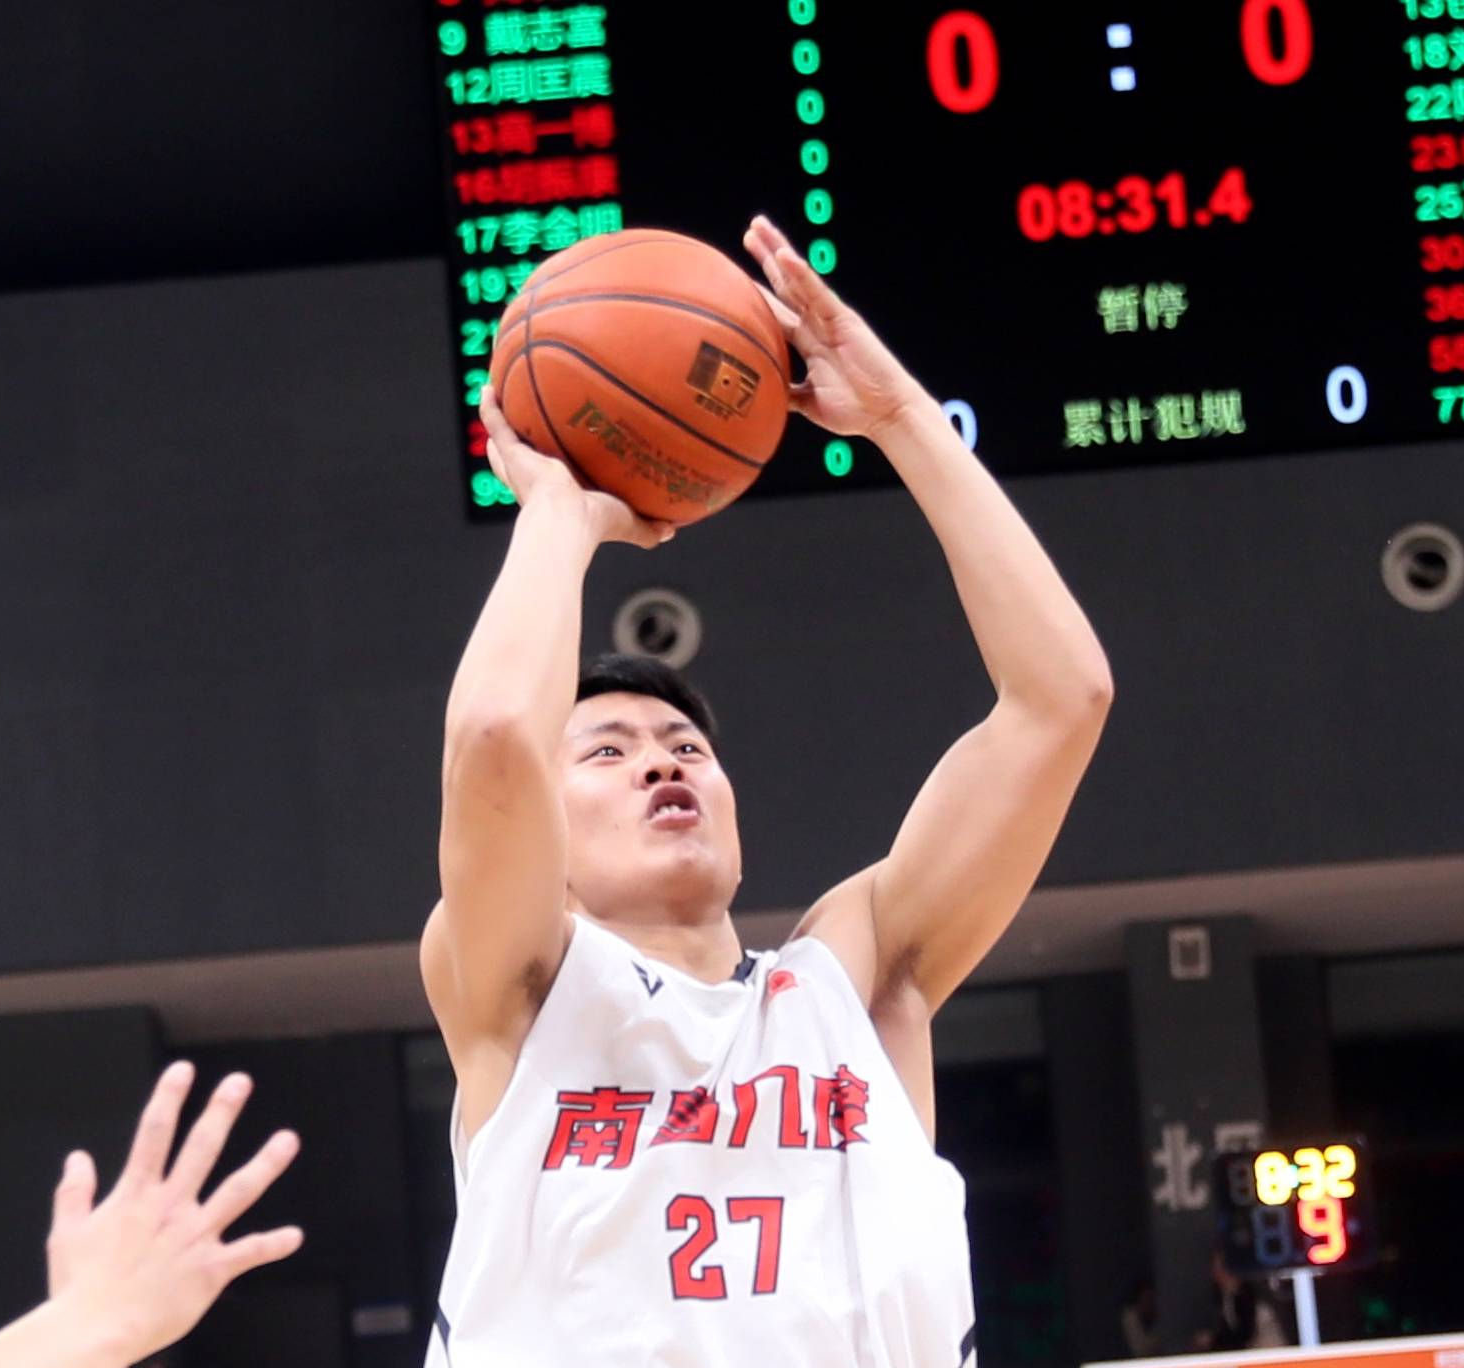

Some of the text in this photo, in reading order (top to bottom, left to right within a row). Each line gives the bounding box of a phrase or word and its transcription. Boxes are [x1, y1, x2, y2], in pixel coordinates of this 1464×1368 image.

[438, 20, 467, 56] 9
[792, 39, 821, 75] 0
[927, 10, 999, 113] 0
[1240, 0, 1314, 85] 0
[796, 89, 825, 125] 0
[800, 139, 829, 175] 0
[804, 188, 833, 225] 0
[1016, 167, 1253, 241] 08:31.4
[808, 239, 837, 275] 0
[1097, 282, 1188, 334] 暂停
[1326, 365, 1368, 424] 0
[1063, 389, 1247, 448] 累计犯规
[823, 440, 853, 477] 0
[1254, 1144, 1356, 1206] 8:32
[665, 1194, 785, 1301] 27
